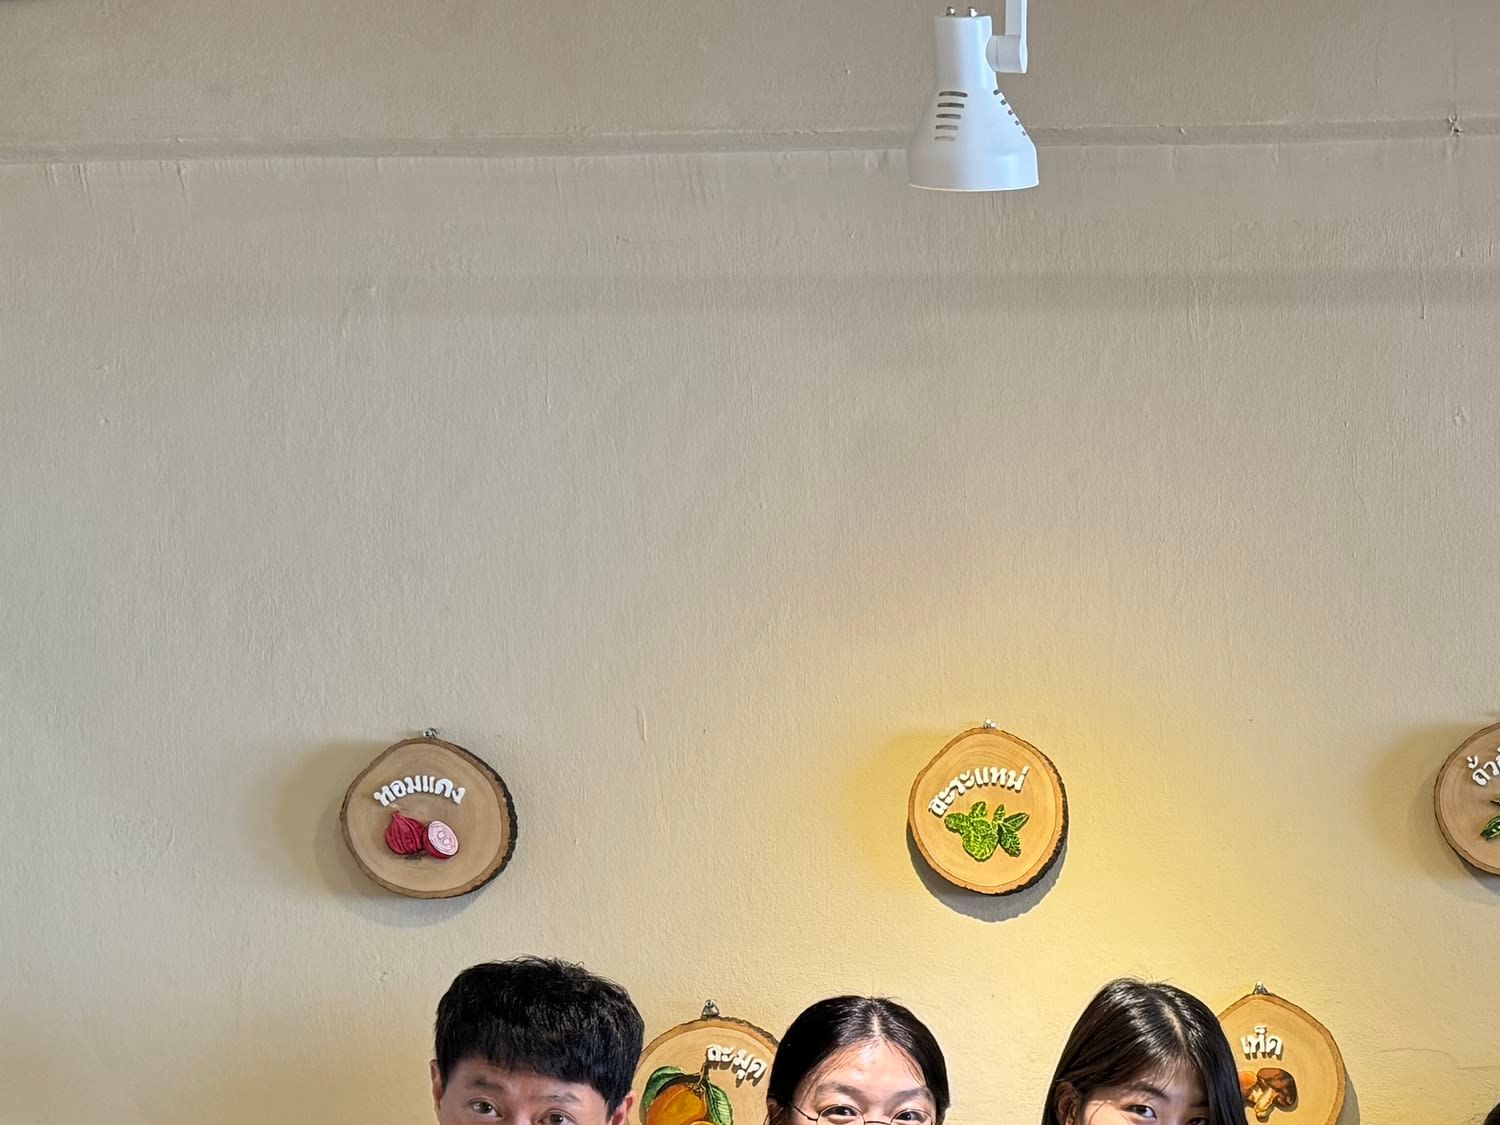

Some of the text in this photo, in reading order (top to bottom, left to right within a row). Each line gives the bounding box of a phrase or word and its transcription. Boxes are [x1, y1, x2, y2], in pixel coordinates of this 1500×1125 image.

[373, 775, 466, 807] หอมแดง
[928, 765, 1030, 817] สะระแหน่
[1240, 1024, 1283, 1056] เห็ด
[706, 1044, 767, 1080] ละมุด
